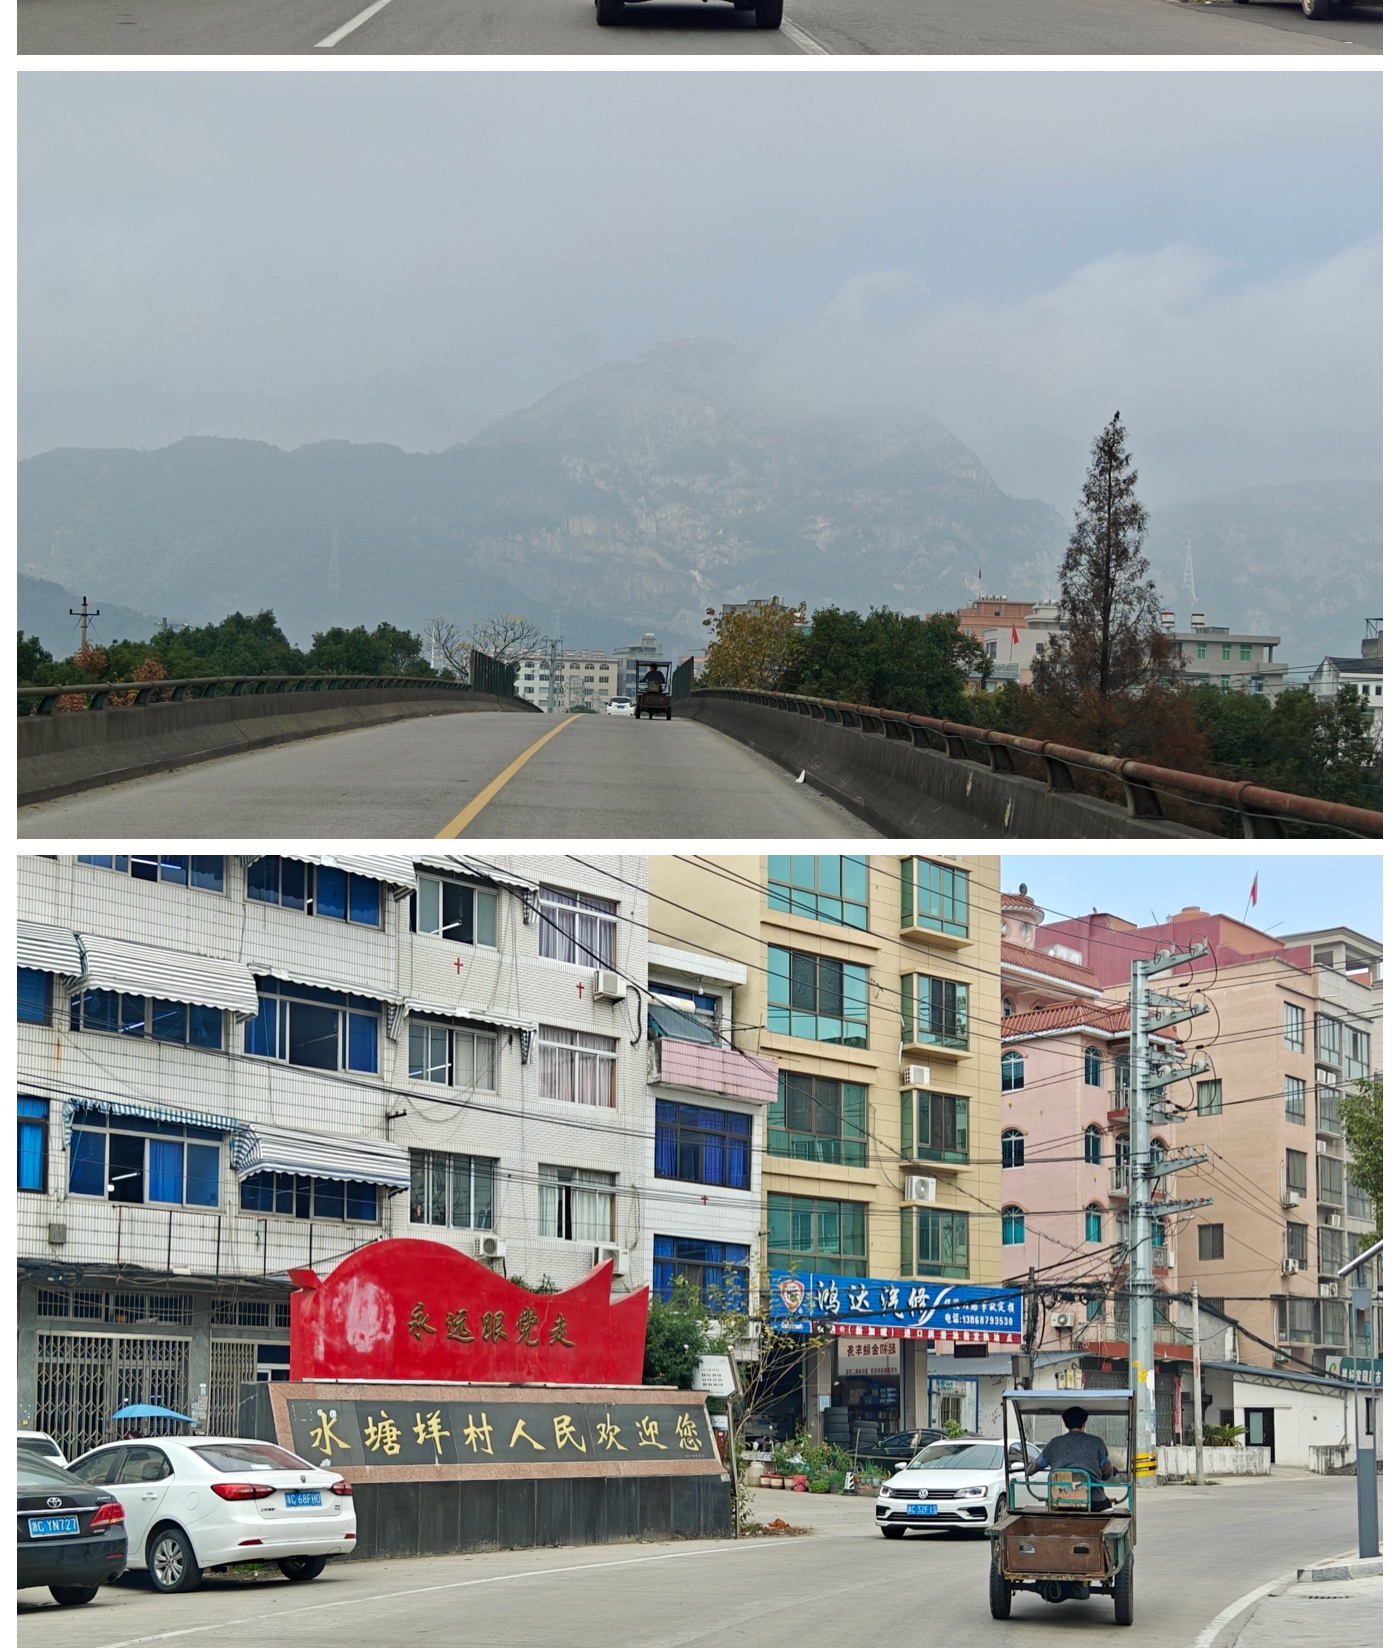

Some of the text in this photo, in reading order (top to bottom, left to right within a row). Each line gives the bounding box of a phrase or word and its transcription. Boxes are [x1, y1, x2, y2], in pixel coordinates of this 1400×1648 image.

[817, 1280, 930, 1320] 鸿达汽修
[310, 1409, 702, 1456] 水塘垟村人民欢迎您
